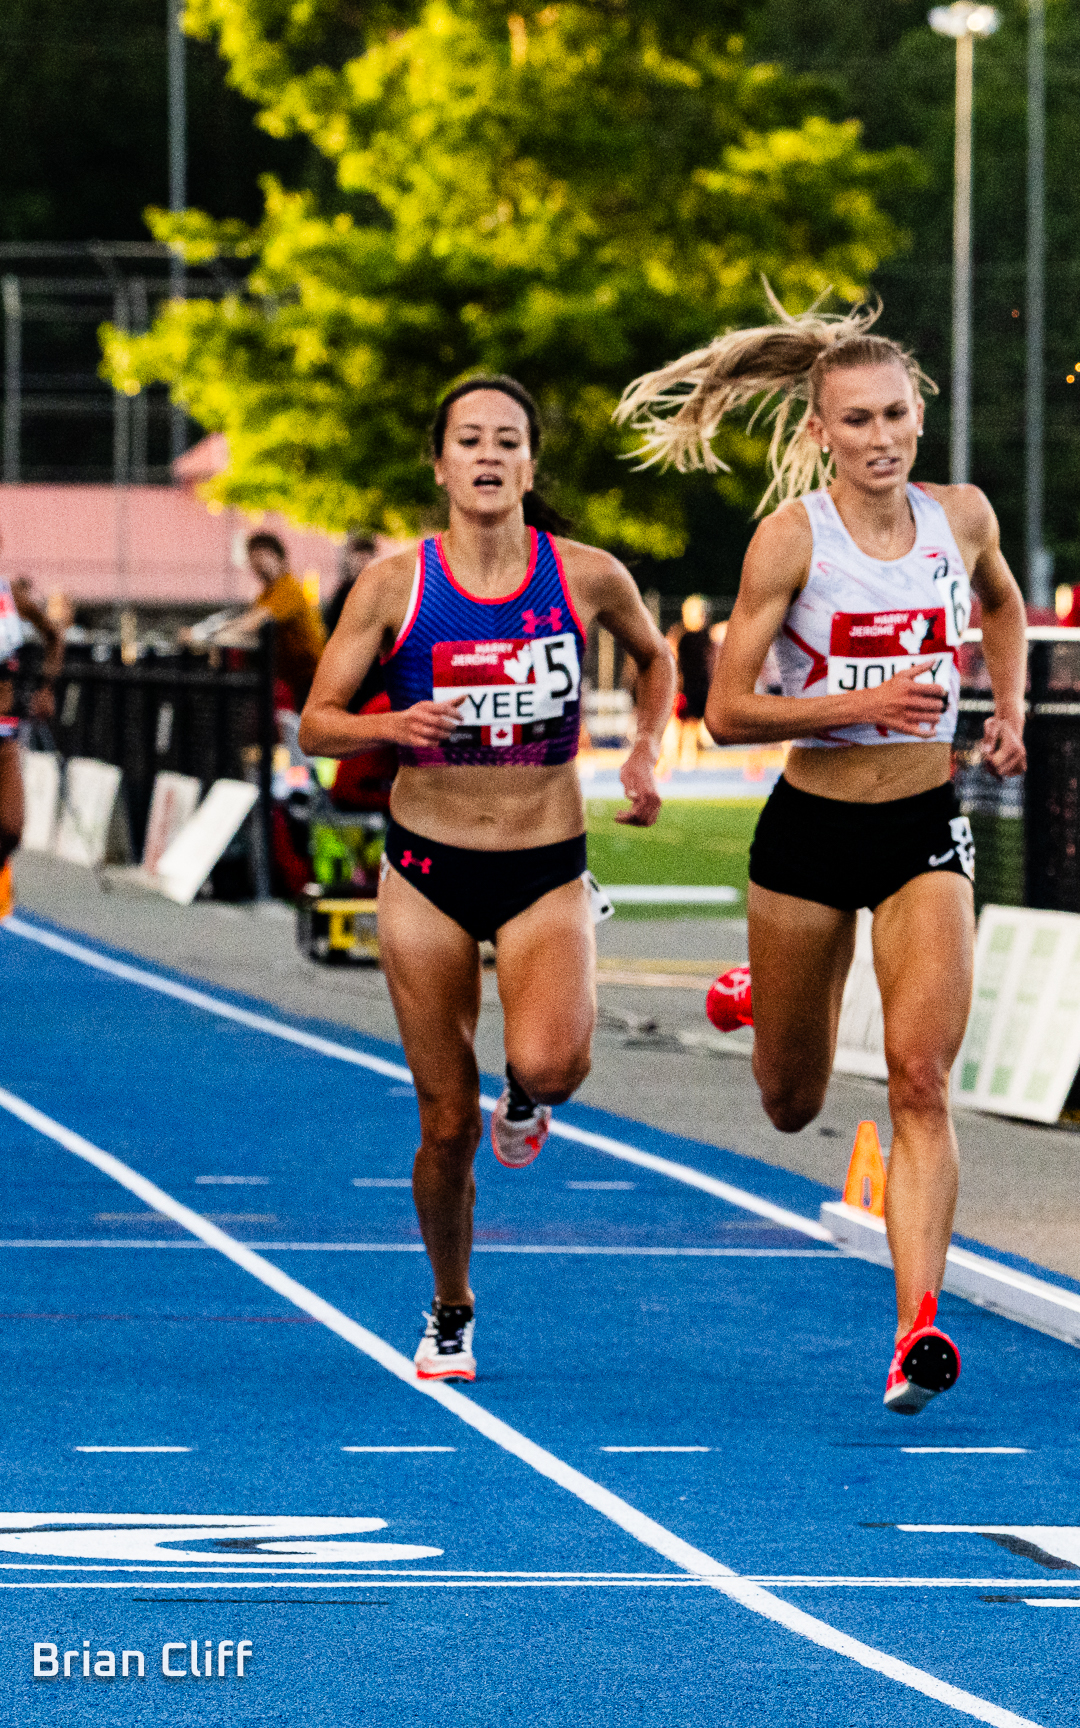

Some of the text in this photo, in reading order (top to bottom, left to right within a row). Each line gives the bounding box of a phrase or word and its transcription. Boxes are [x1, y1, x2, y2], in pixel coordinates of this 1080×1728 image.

[873, 612, 910, 625] HARRY
[848, 624, 895, 638] JEROME
[450, 653, 499, 667] JEROME
[544, 641, 573, 699] 5
[839, 658, 943, 691] JOY
[467, 691, 535, 719] YEE
